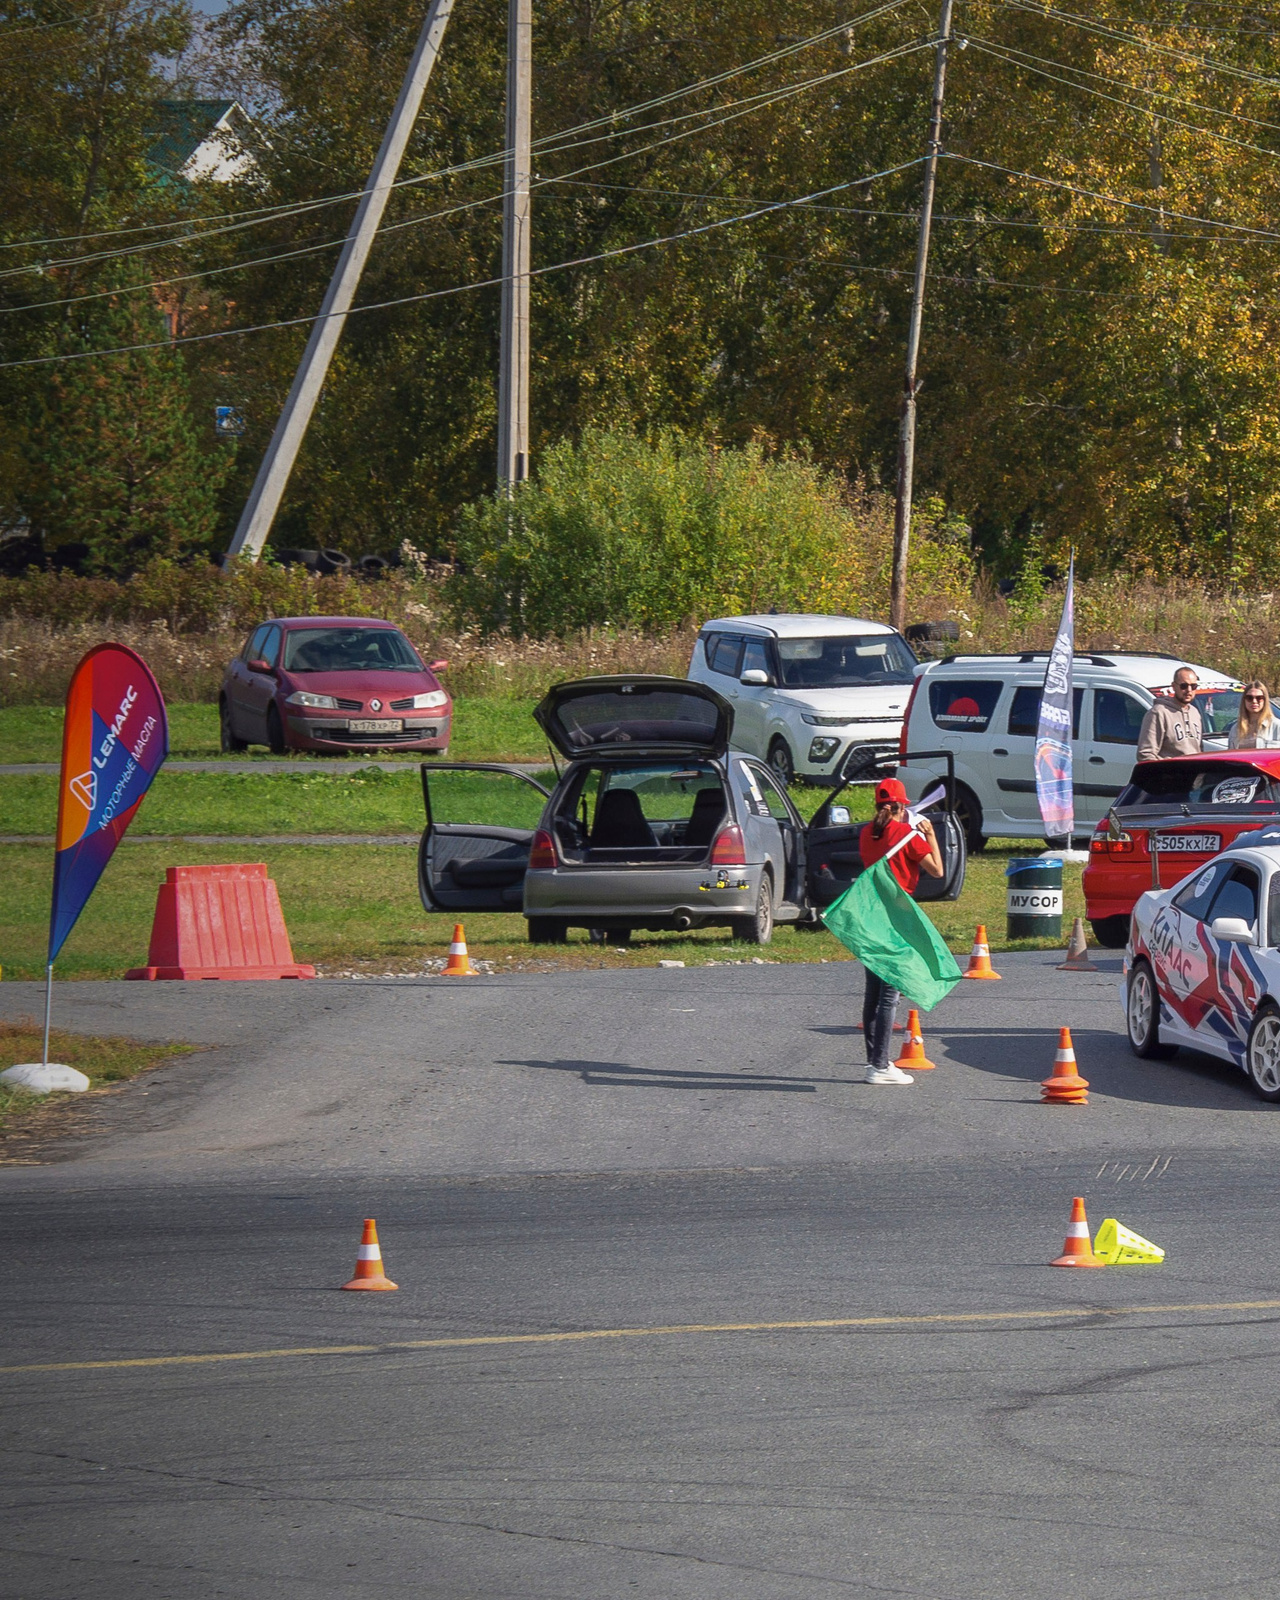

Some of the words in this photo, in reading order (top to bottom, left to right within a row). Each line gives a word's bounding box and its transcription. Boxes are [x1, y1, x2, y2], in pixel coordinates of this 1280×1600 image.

[92, 685, 138, 769] LEMARC
[98, 757, 137, 831] МОТОРНЫЕ
[131, 715, 158, 762] МАСЛА
[1204, 836, 1217, 846] 72
[1010, 895, 1059, 908] МУСОР
